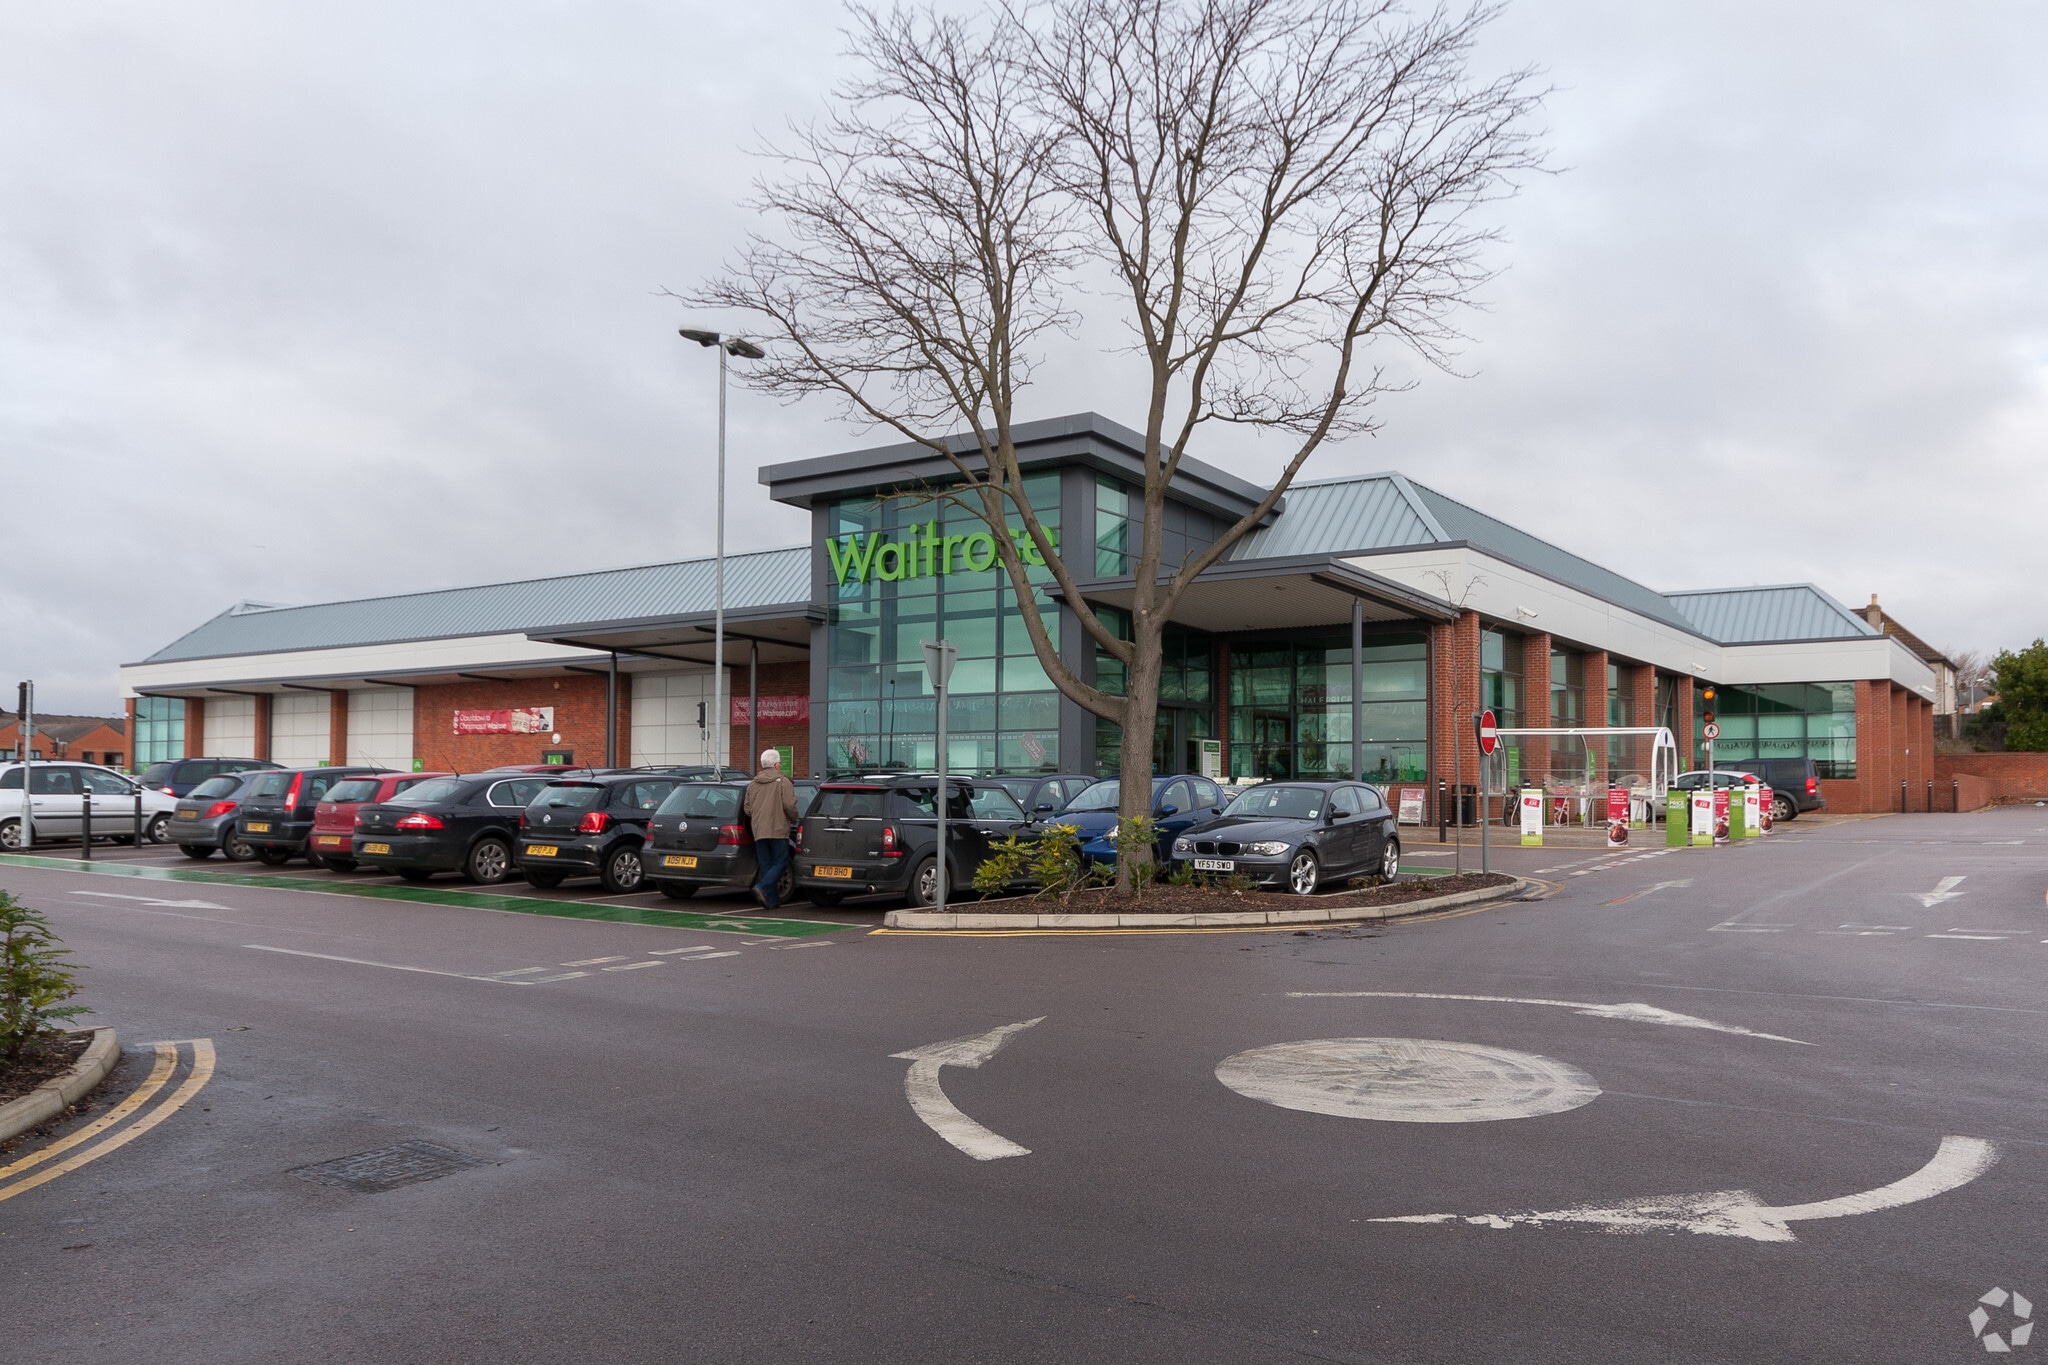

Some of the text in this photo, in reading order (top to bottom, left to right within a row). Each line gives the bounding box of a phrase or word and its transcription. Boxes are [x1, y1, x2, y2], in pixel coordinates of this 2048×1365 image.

[762, 709, 798, 718] Waitrose.com
[1197, 860, 1231, 870] YF57 SWO
[817, 866, 848, 877] ET10 BHO
